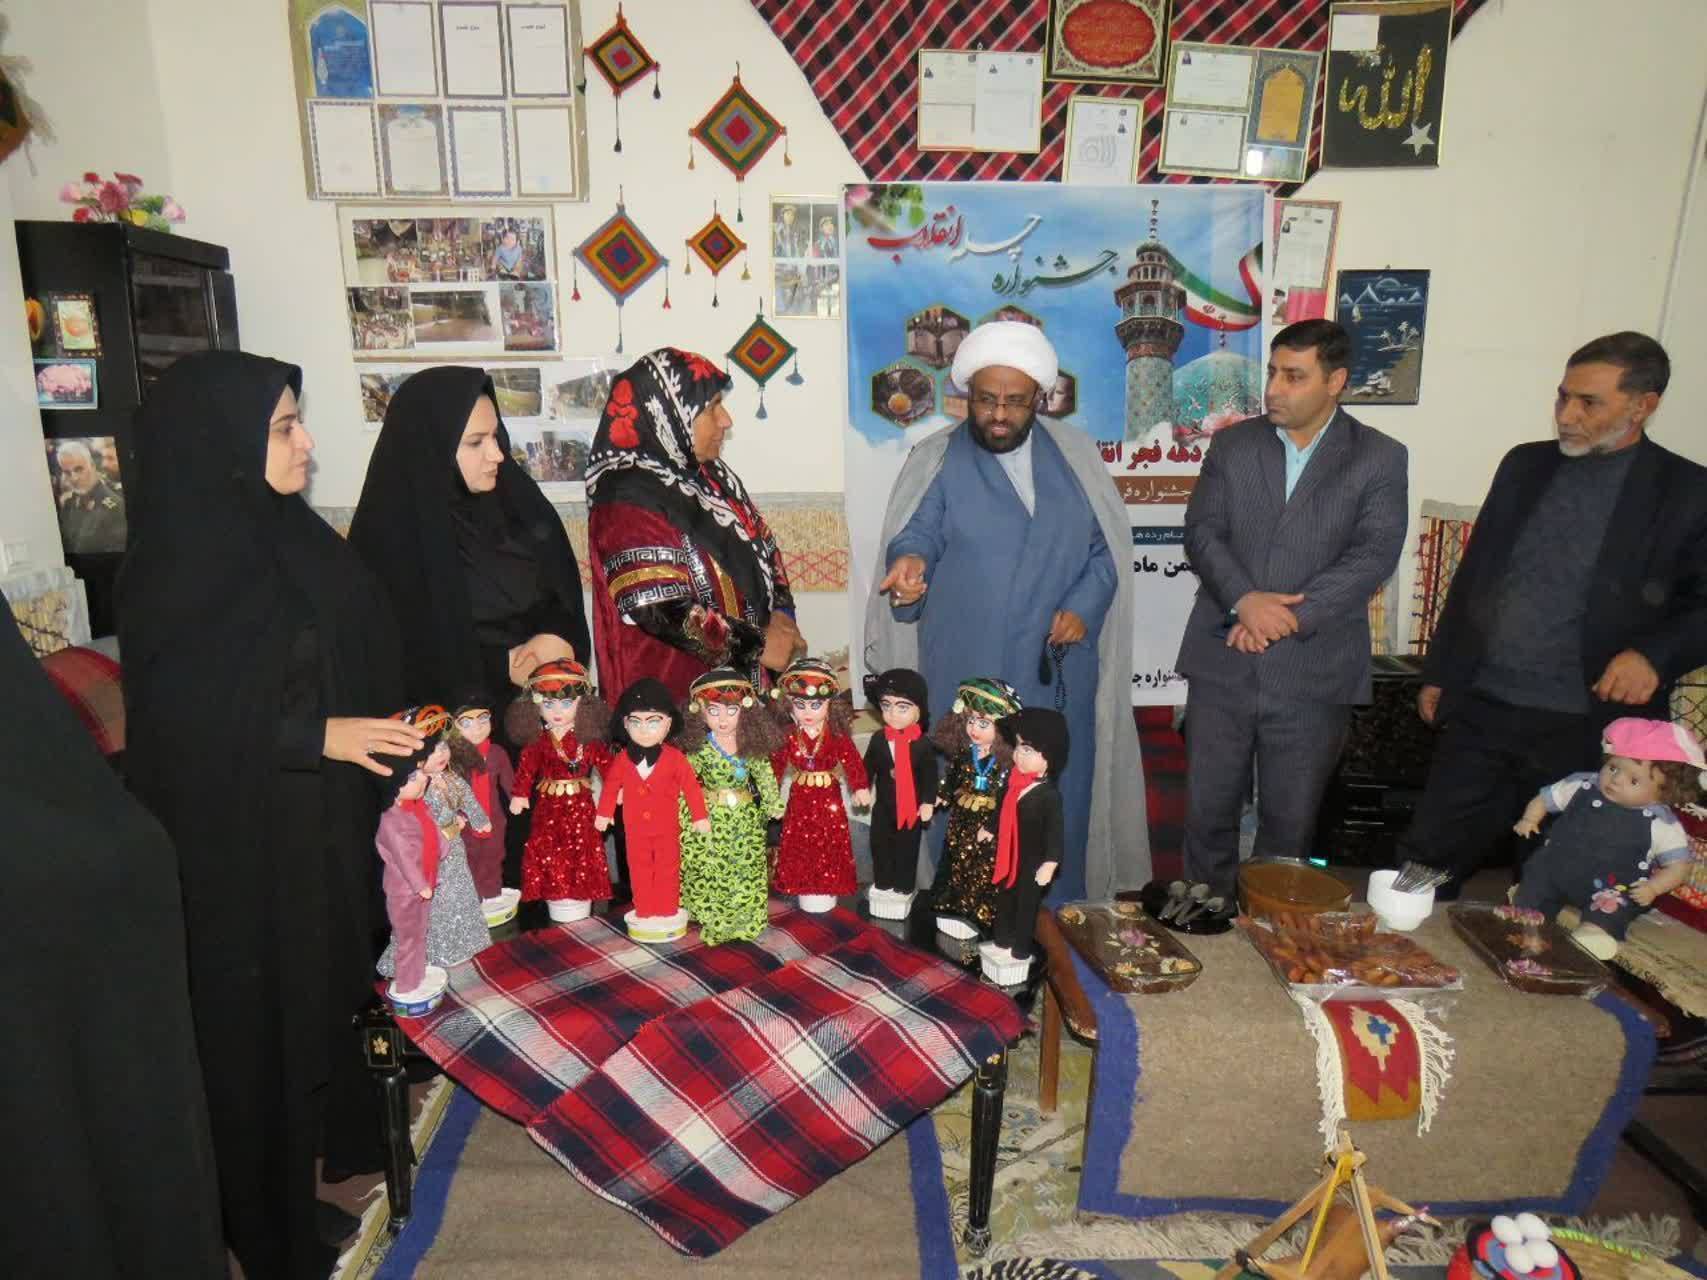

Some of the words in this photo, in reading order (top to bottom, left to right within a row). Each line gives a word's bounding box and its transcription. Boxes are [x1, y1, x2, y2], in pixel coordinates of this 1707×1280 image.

[1338, 44, 1433, 130] الله
[867, 204, 965, 264] انقلاب
[991, 248, 1119, 297] جشنواره
[1126, 438, 1163, 470] فجر
[1166, 444, 1202, 463] دهه
[1133, 479, 1192, 502] جشنواره
